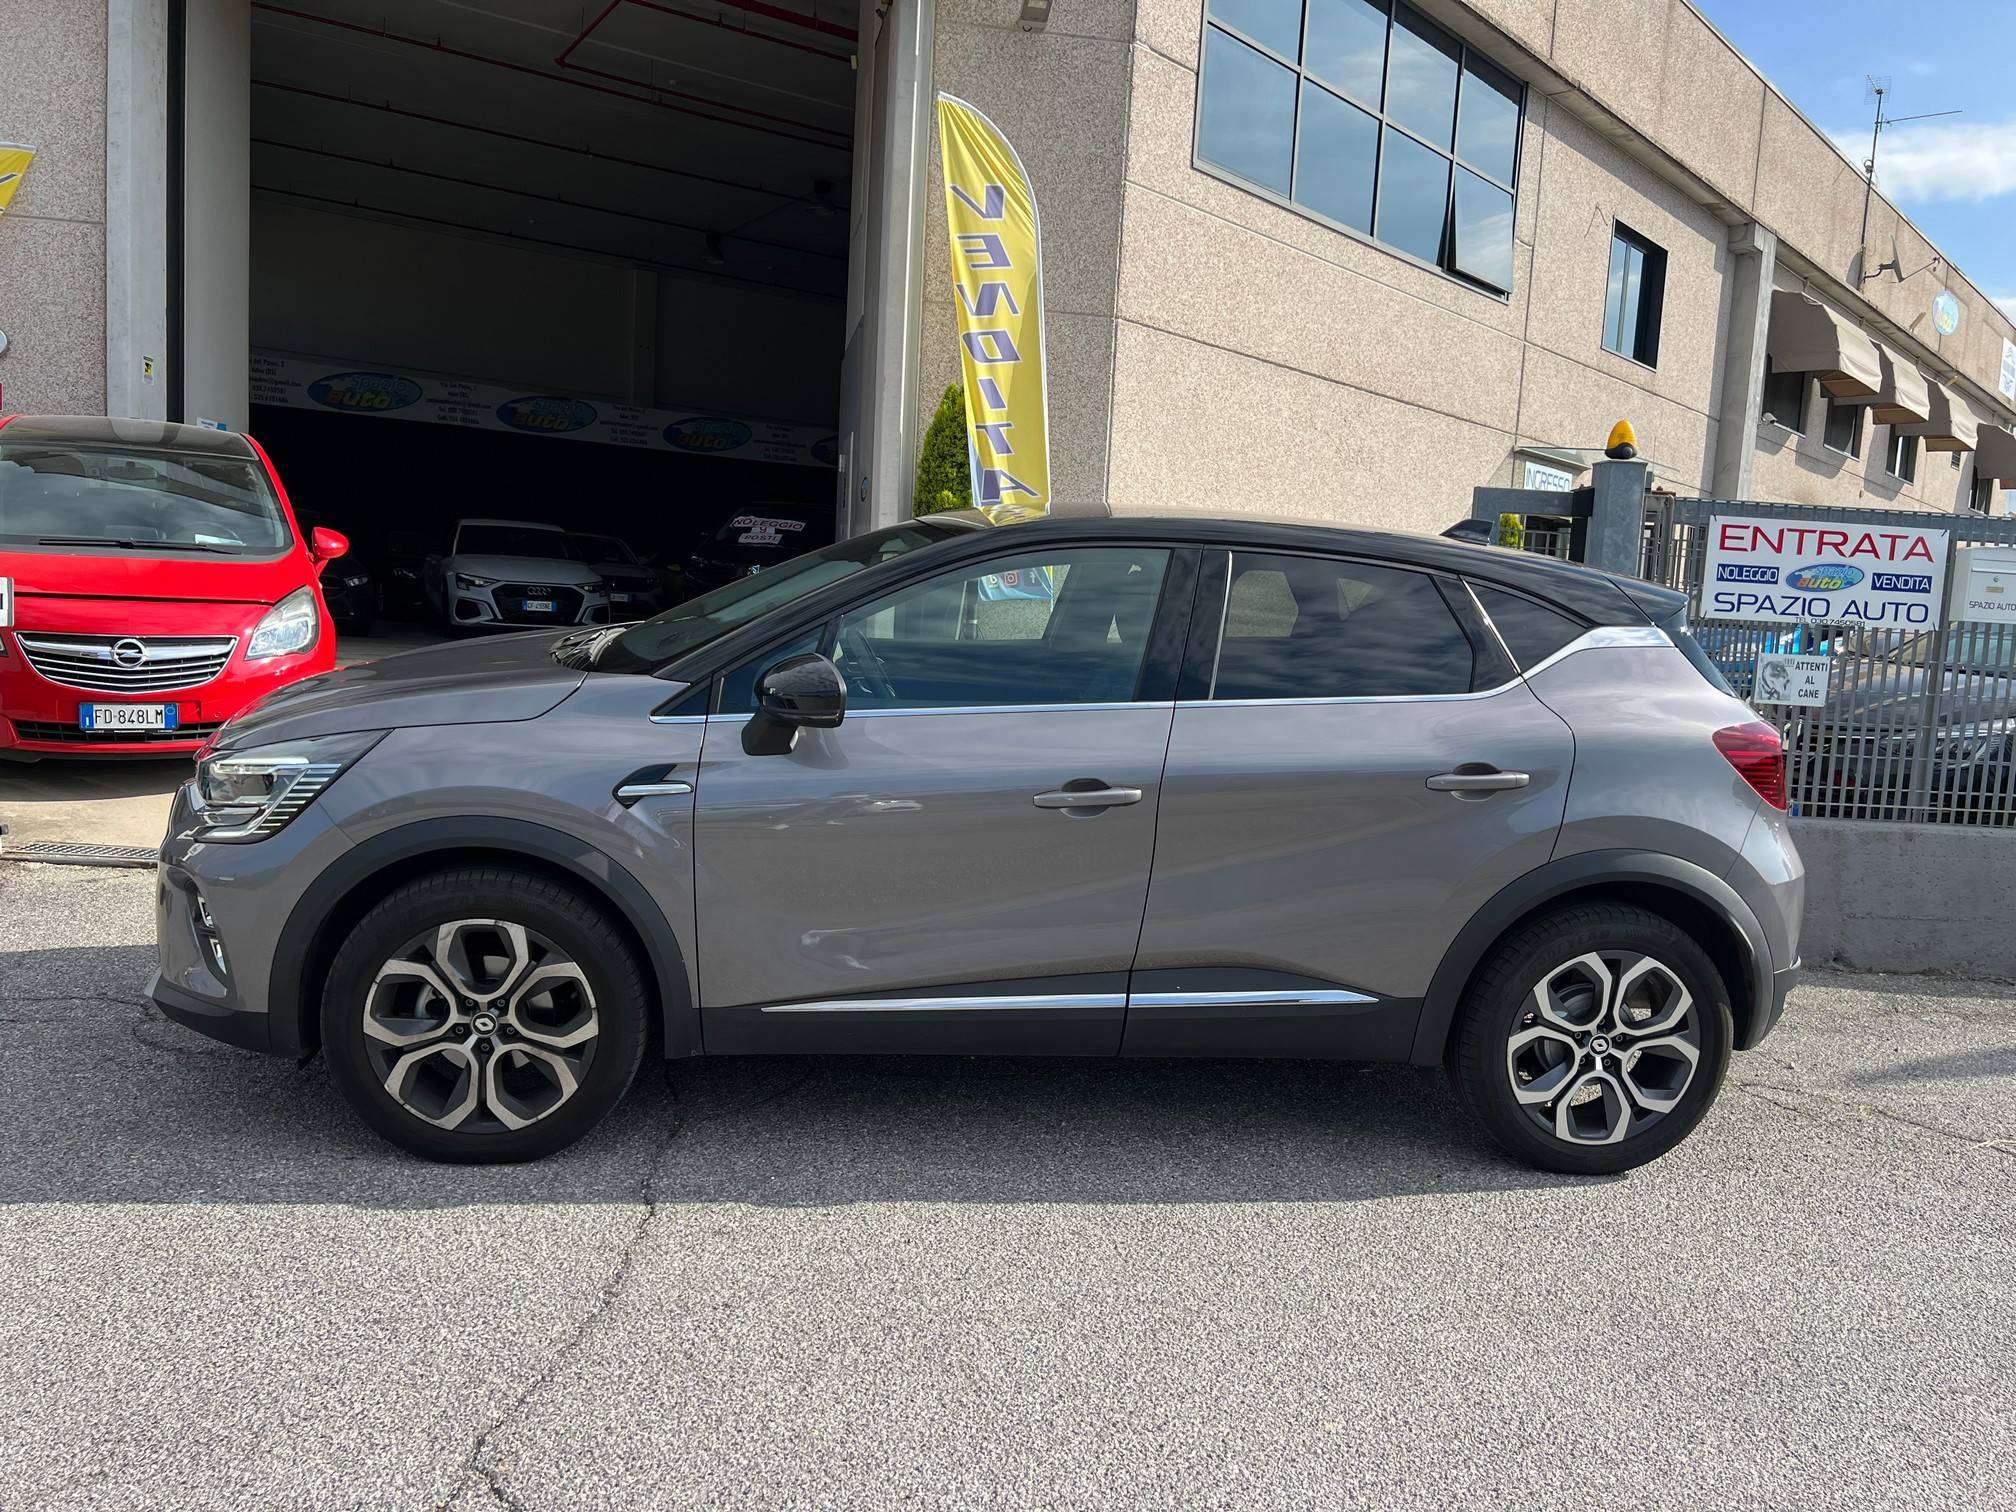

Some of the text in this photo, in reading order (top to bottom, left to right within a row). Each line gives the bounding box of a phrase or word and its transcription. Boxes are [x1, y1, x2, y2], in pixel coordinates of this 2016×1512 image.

[1718, 524, 1935, 563] ENTRATA
[1718, 566, 1778, 582] NOLEGGIO
[1873, 574, 1932, 591] VENDITA
[1714, 592, 1929, 624] SPAZIO AUTO
[1968, 600, 2016, 611] SPAZIO AUTO
[1795, 661, 1828, 672] ATTENTI
[1804, 675, 1815, 685] AL
[1798, 688, 1820, 699] CANE
